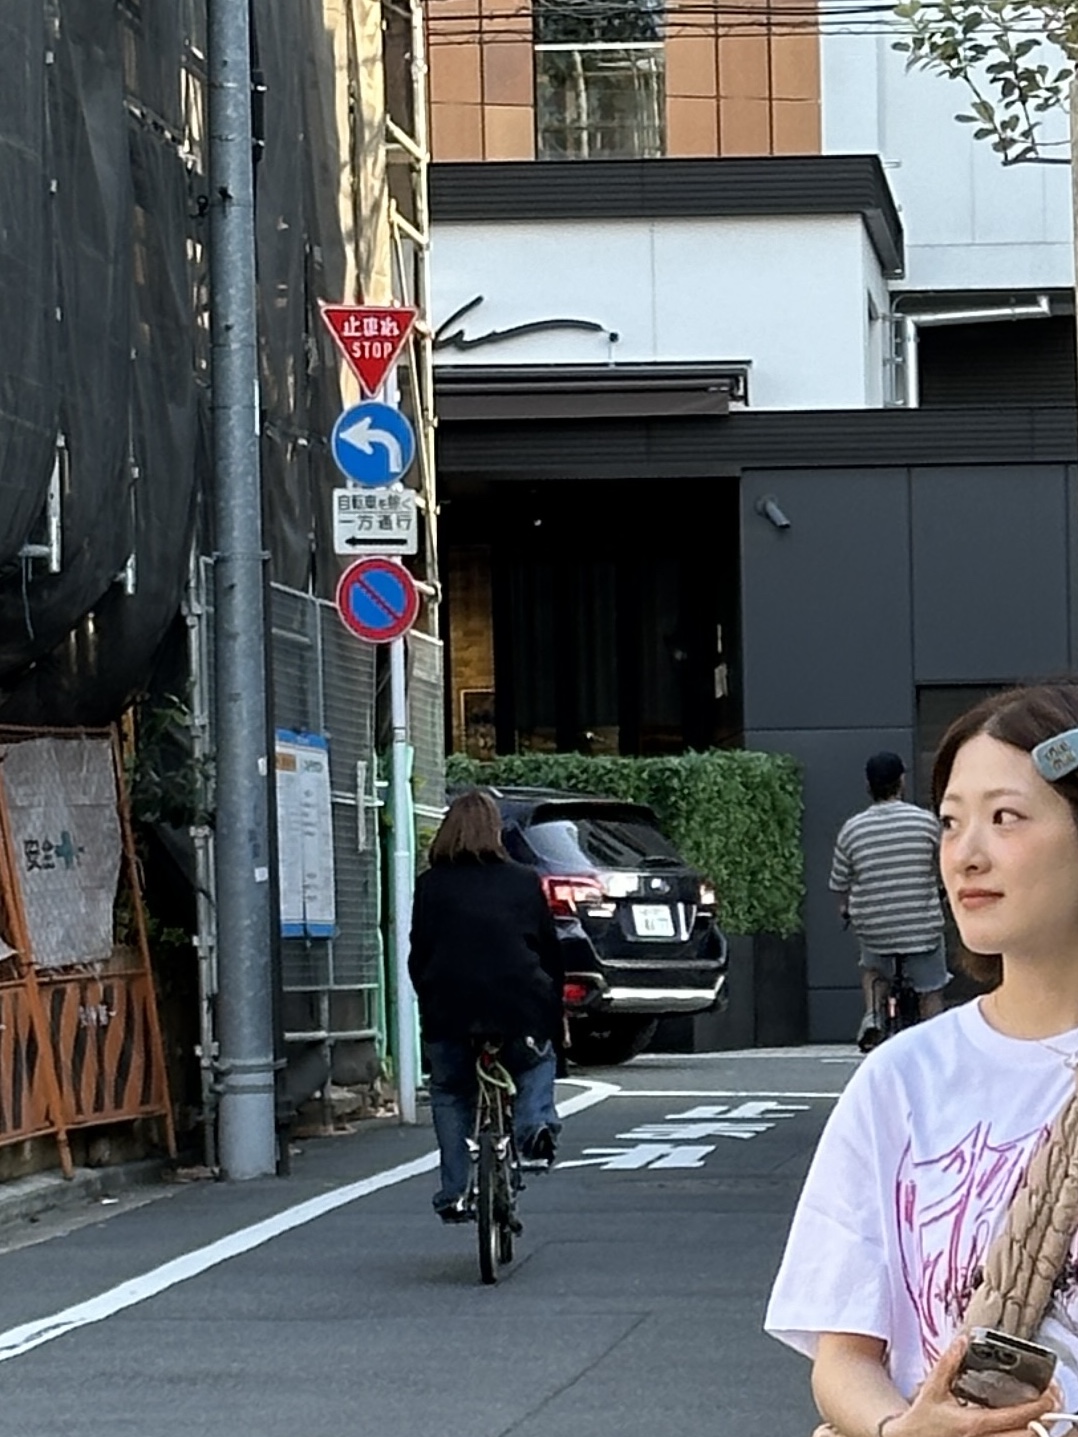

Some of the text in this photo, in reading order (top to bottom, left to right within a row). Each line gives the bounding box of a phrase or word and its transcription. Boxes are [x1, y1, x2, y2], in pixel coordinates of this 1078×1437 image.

[343, 315, 400, 337] 止まれ
[351, 341, 393, 359] STOP
[338, 494, 412, 510] 自転車を除く
[338, 514, 412, 531] 一方通行
